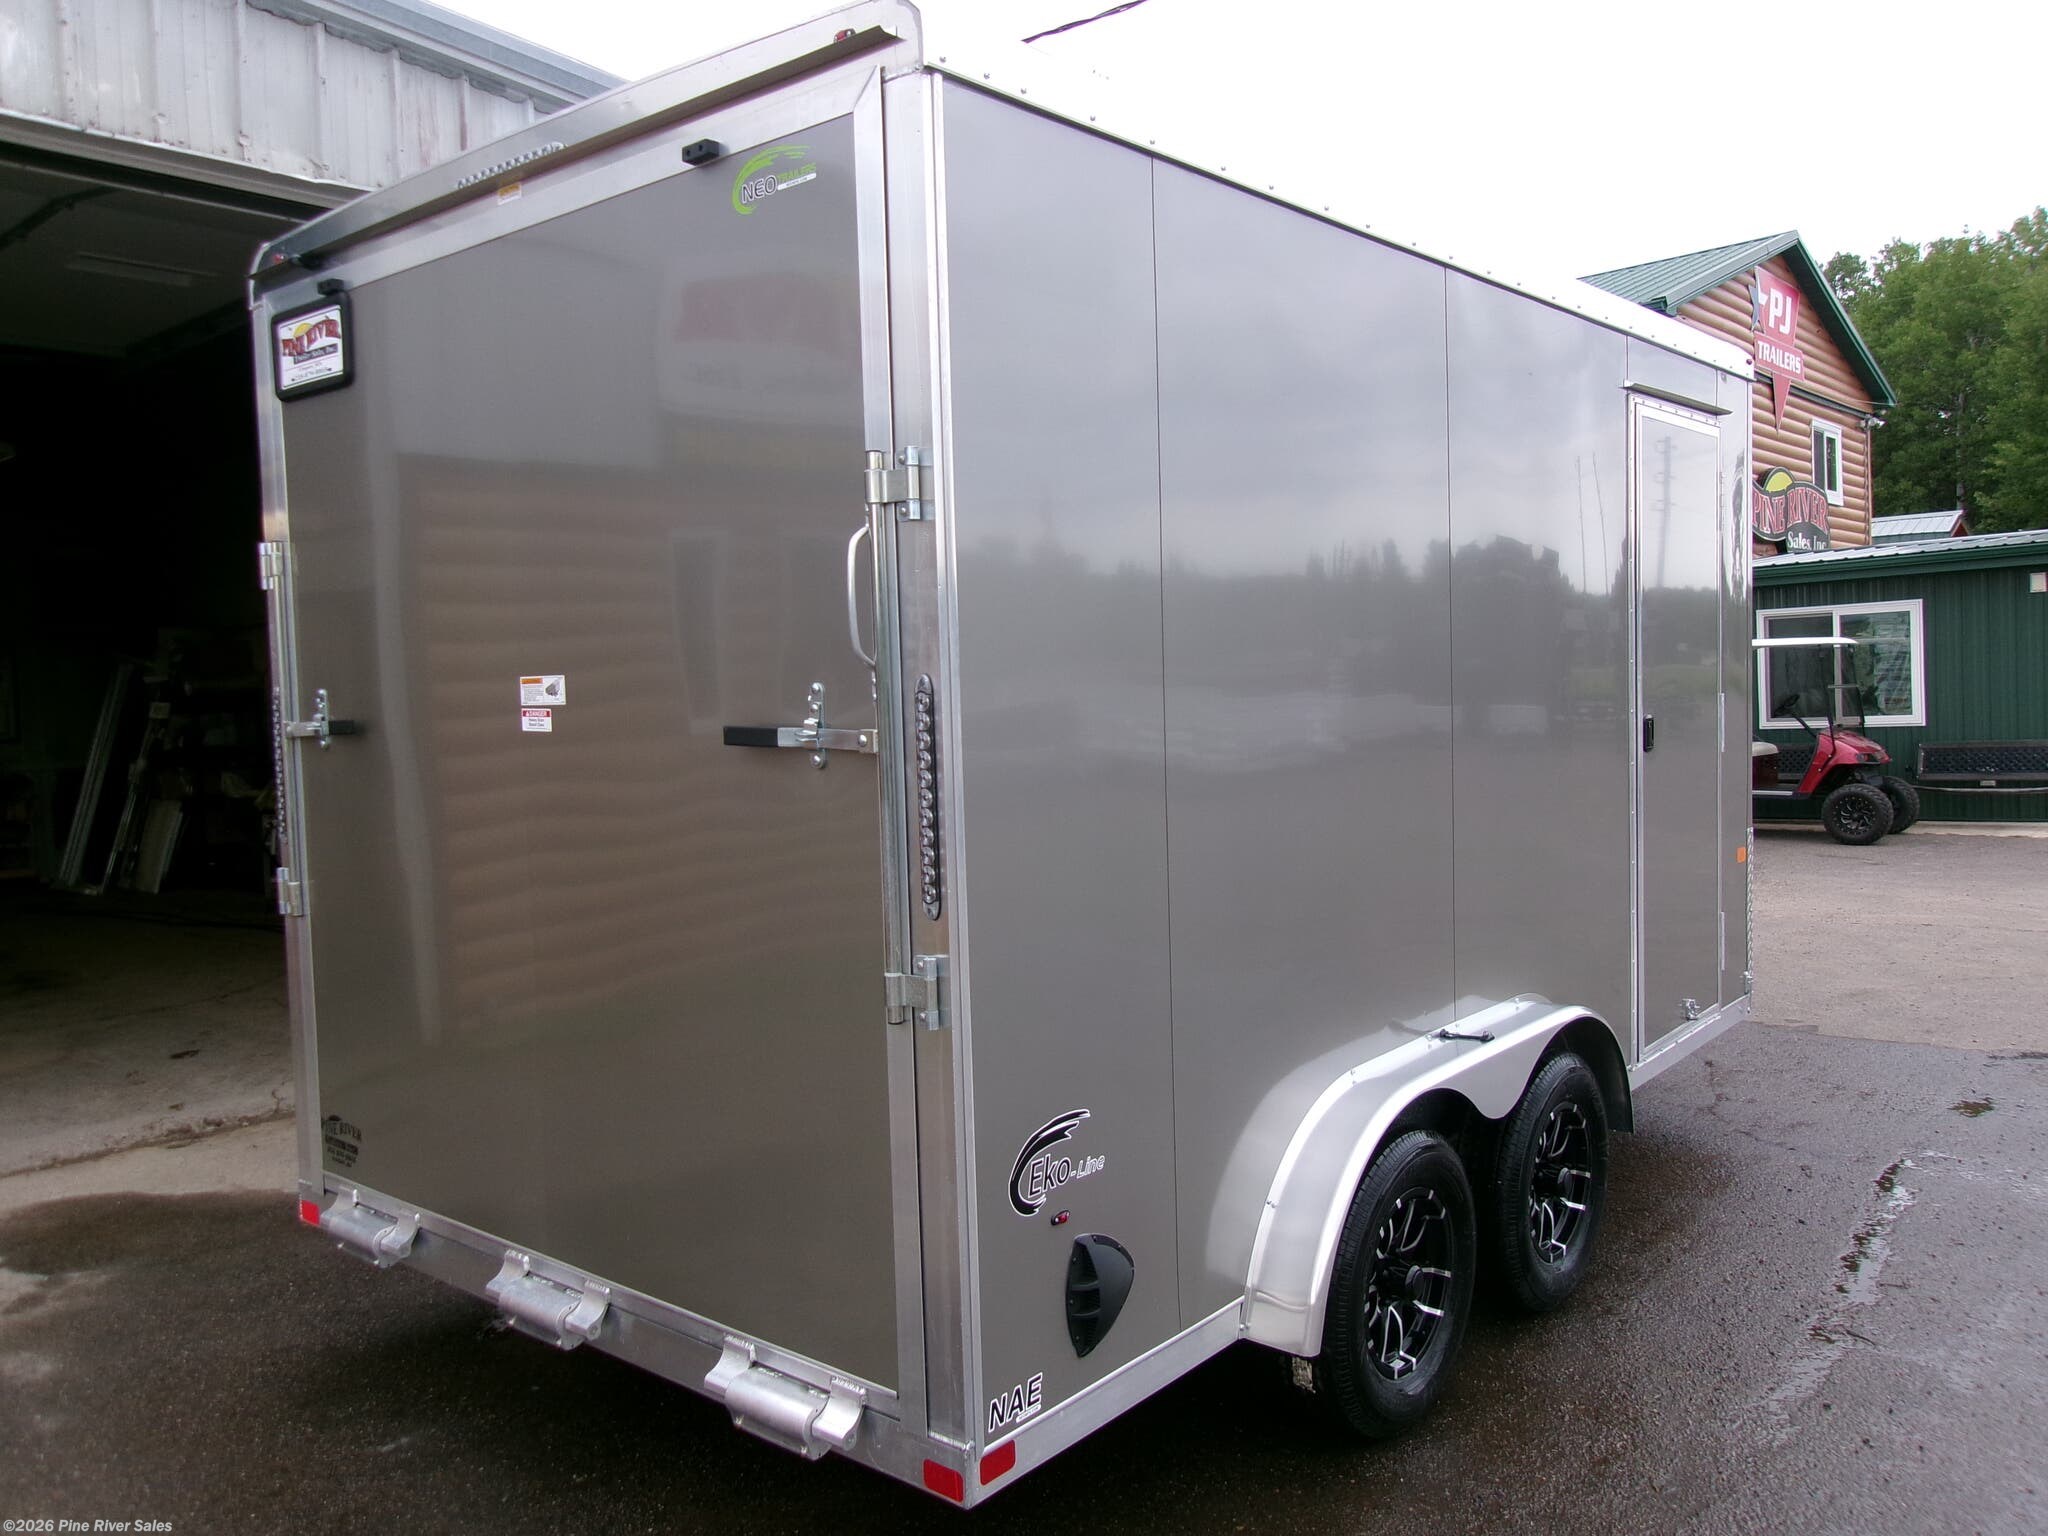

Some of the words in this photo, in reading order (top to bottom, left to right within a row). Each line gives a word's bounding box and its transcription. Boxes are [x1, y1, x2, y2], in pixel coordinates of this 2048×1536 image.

[741, 175, 777, 204] NEO
[1768, 287, 1792, 335] PJ
[1757, 341, 1801, 375] TRAILERS
[1752, 487, 1785, 534] PINE
[1787, 487, 1828, 535] RIVER
[1028, 1154, 1106, 1198] Eko-Line
[988, 1372, 1043, 1433] NAE
